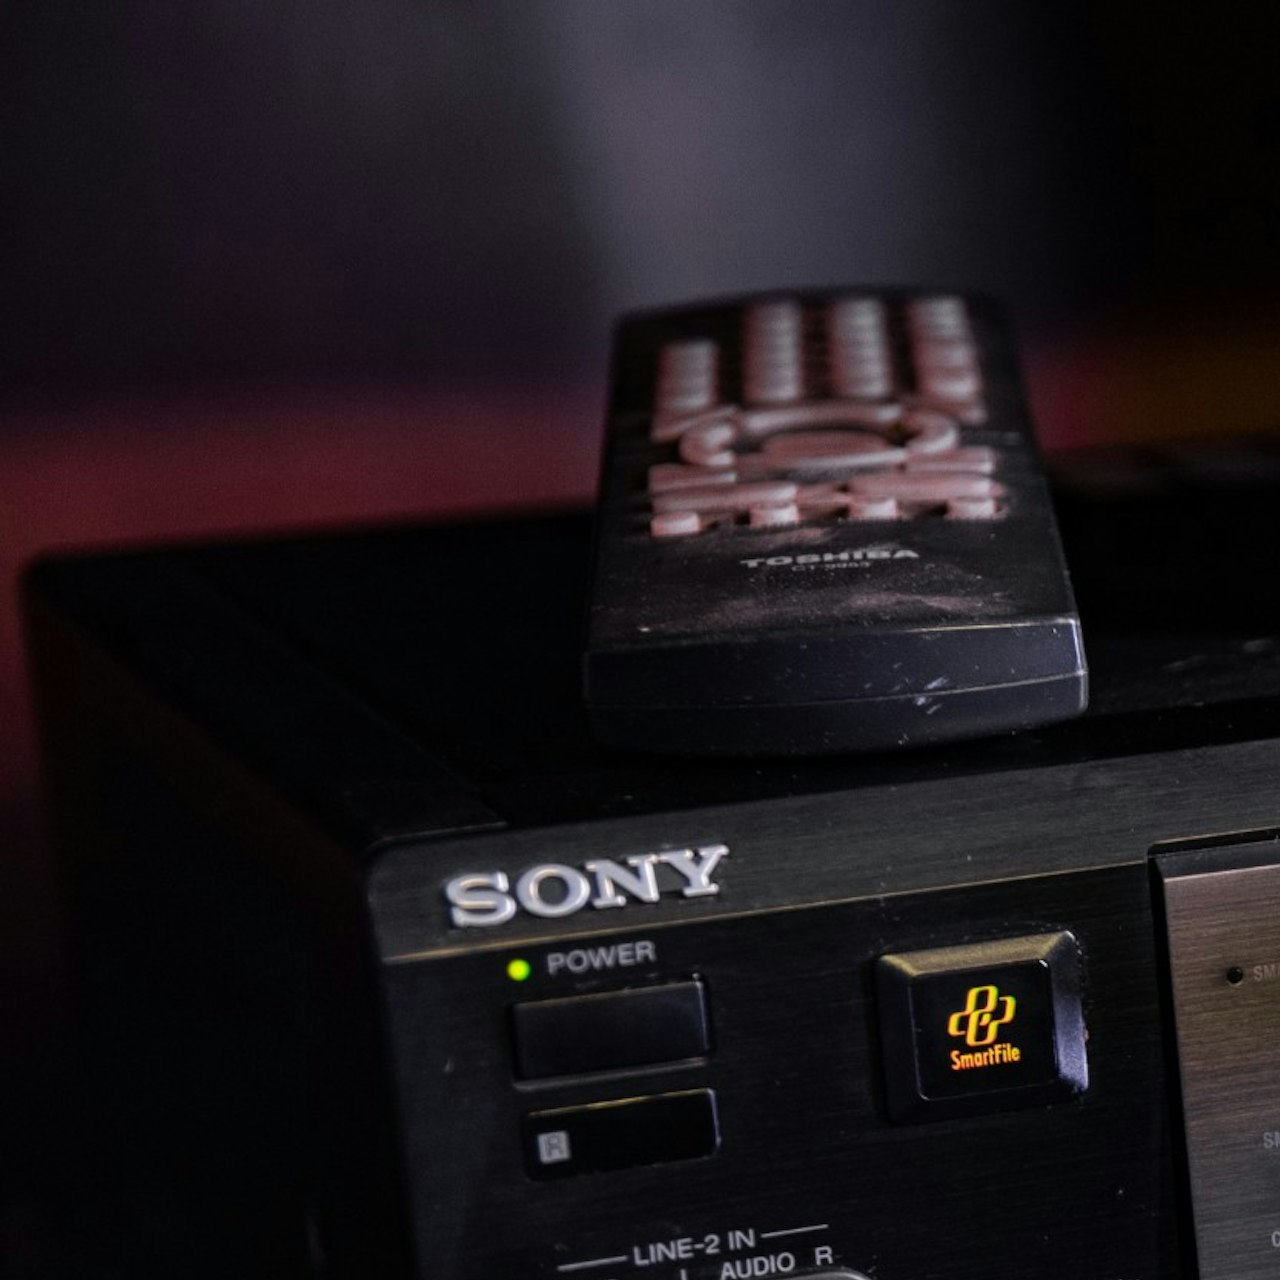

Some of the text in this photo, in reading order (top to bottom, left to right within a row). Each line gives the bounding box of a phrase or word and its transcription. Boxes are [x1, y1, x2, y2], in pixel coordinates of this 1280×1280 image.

[740, 550, 919, 567] TOSHIBA
[445, 844, 729, 927] SONY
[547, 940, 656, 976] POWER
[950, 1041, 1022, 1070] SmartFile
[632, 1230, 756, 1266] LINE-2 IN
[815, 1245, 834, 1266] R
